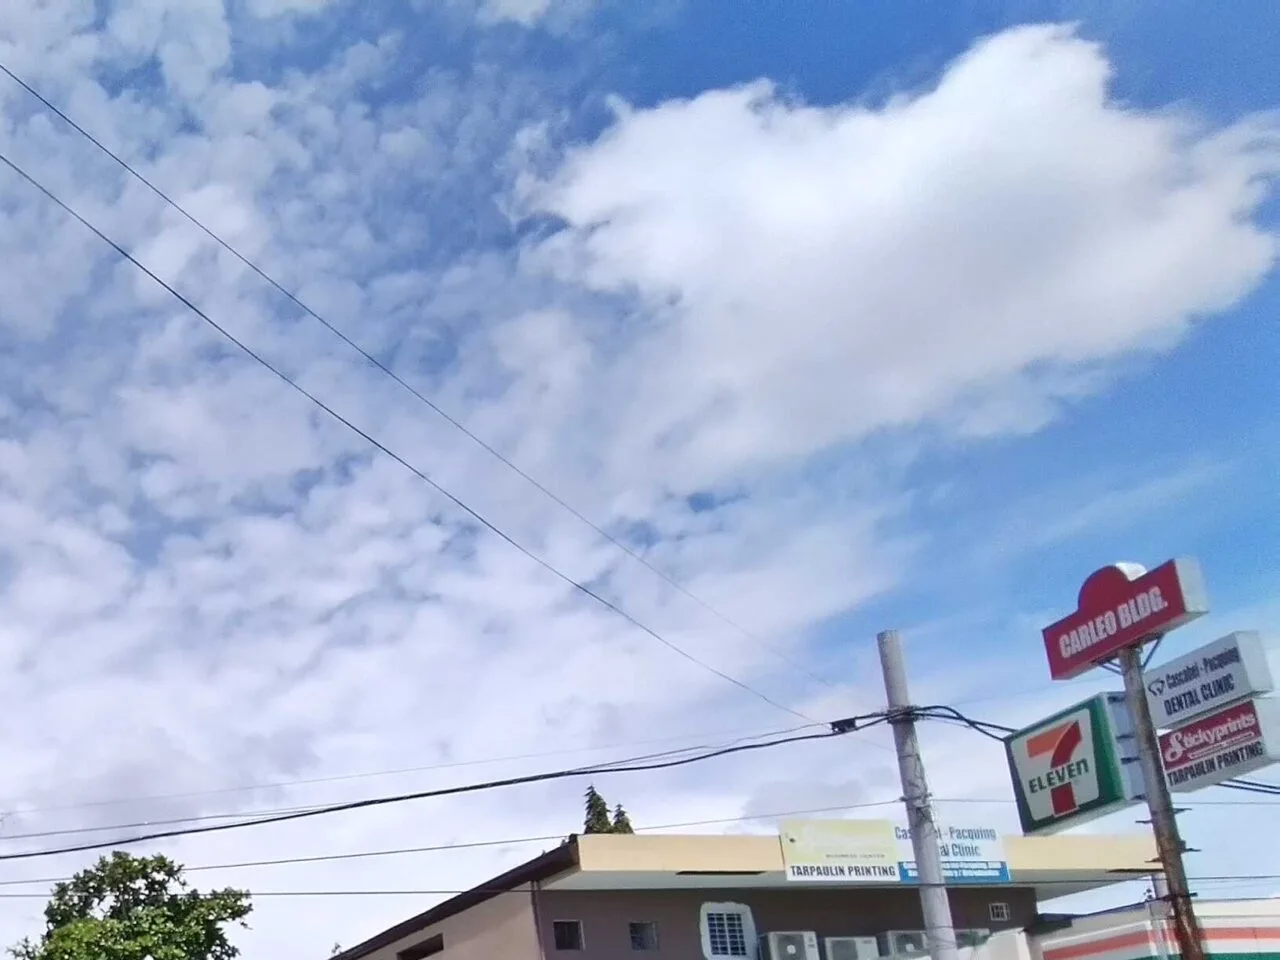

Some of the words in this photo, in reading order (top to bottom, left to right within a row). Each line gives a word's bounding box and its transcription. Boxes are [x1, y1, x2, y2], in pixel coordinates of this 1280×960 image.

[1058, 609, 1117, 658] CARLEO
[1118, 586, 1169, 629] BLDG.
[1163, 688, 1201, 716] DENTAL
[1200, 672, 1235, 701] CLINIC
[1164, 712, 1257, 762] Stickyprints
[1166, 756, 1217, 786] TARPAULIN
[1218, 740, 1264, 769] PRINTING
[791, 865, 846, 877] TARPAULIN
[847, 865, 897, 877] PRINTING
[951, 842, 981, 857] Clinic
